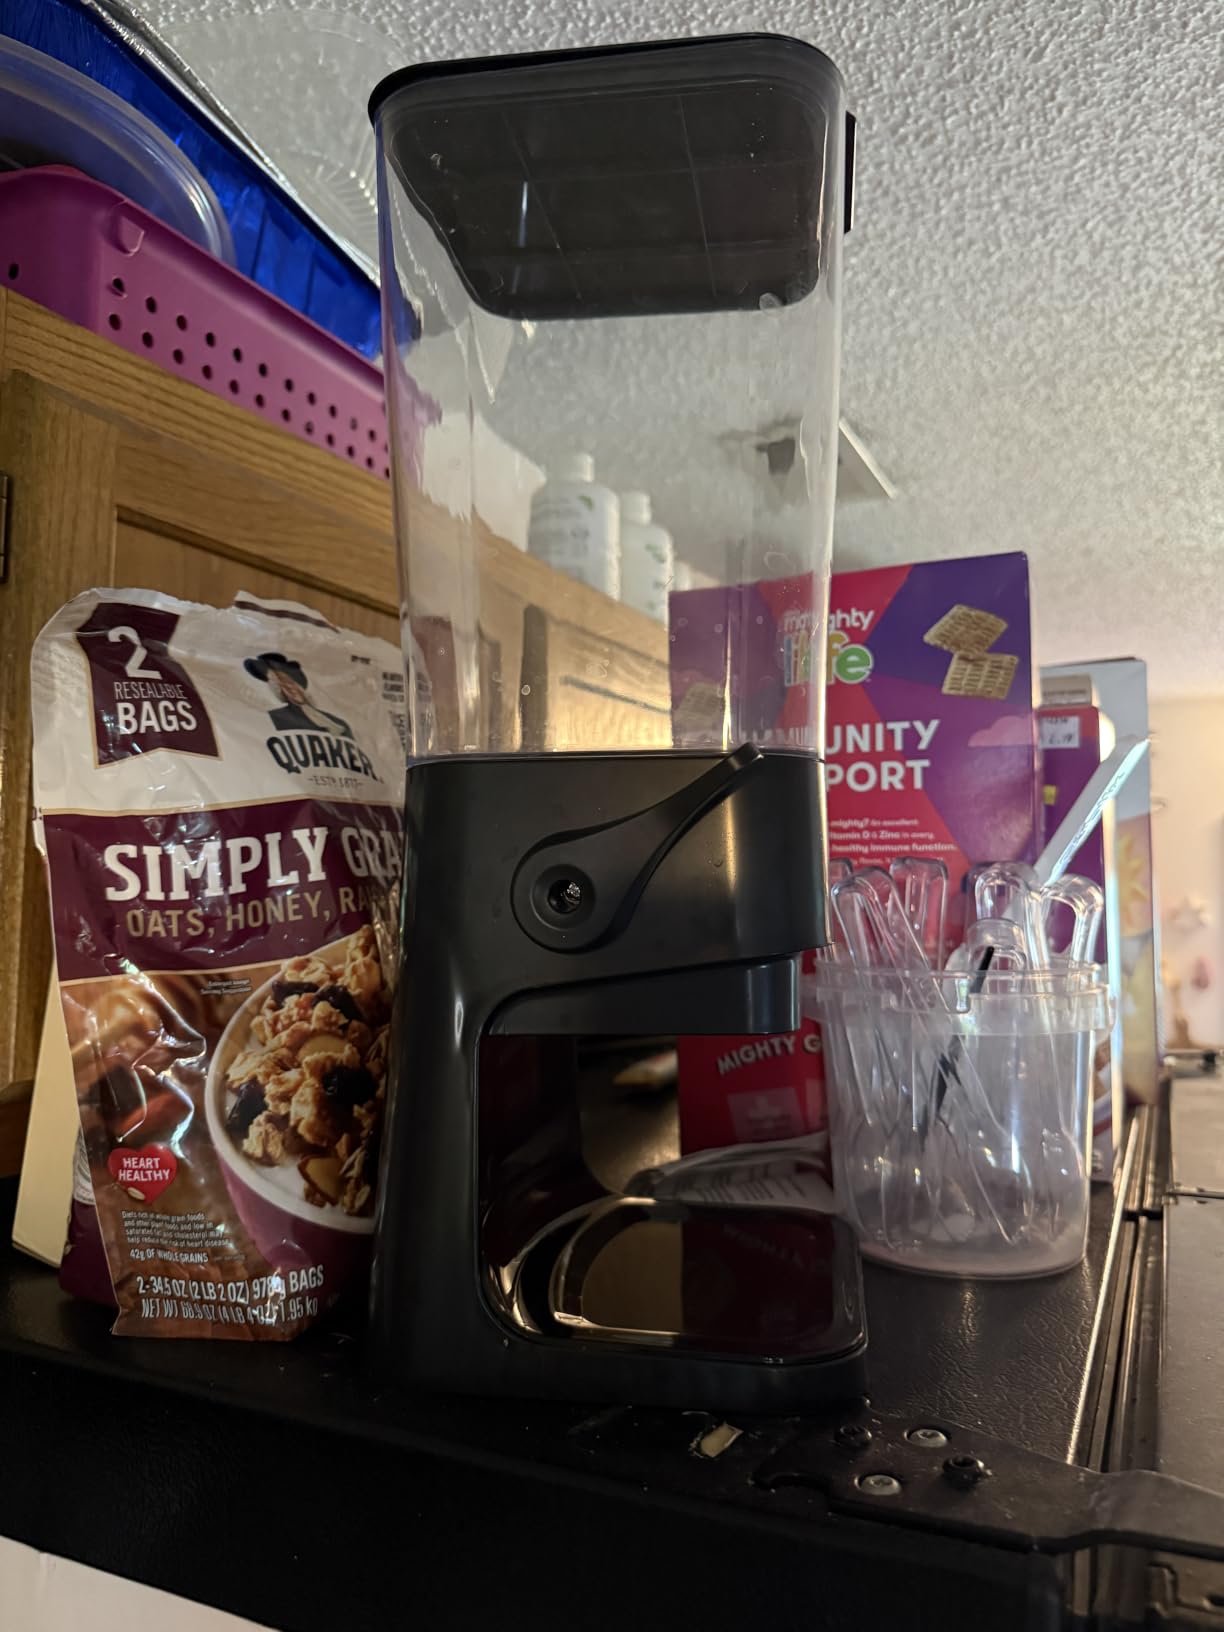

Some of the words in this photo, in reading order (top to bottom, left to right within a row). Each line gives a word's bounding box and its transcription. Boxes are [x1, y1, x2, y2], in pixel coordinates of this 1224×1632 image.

[107, 626, 163, 680] 2
[113, 681, 188, 700] RESEALABLE
[116, 700, 198, 735] BAGS
[266, 734, 379, 782] QUAKER
[103, 826, 329, 901] SIMPLY
[127, 908, 215, 938] OATS,
[225, 889, 330, 932] HONEY,
[716, 1034, 796, 1076] MIGHTY
[118, 1168, 170, 1182] HEALTHY
[122, 1158, 161, 1169] HEART
[130, 1247, 146, 1261] 42g
[146, 1248, 156, 1258] OF
[179, 1251, 209, 1263] GRAINS
[201, 1282, 217, 1300] LB
[228, 1280, 250, 1304] OZ)
[289, 1264, 325, 1293] BAGS
[141, 1298, 161, 1319] NET
[162, 1298, 179, 1319] WT
